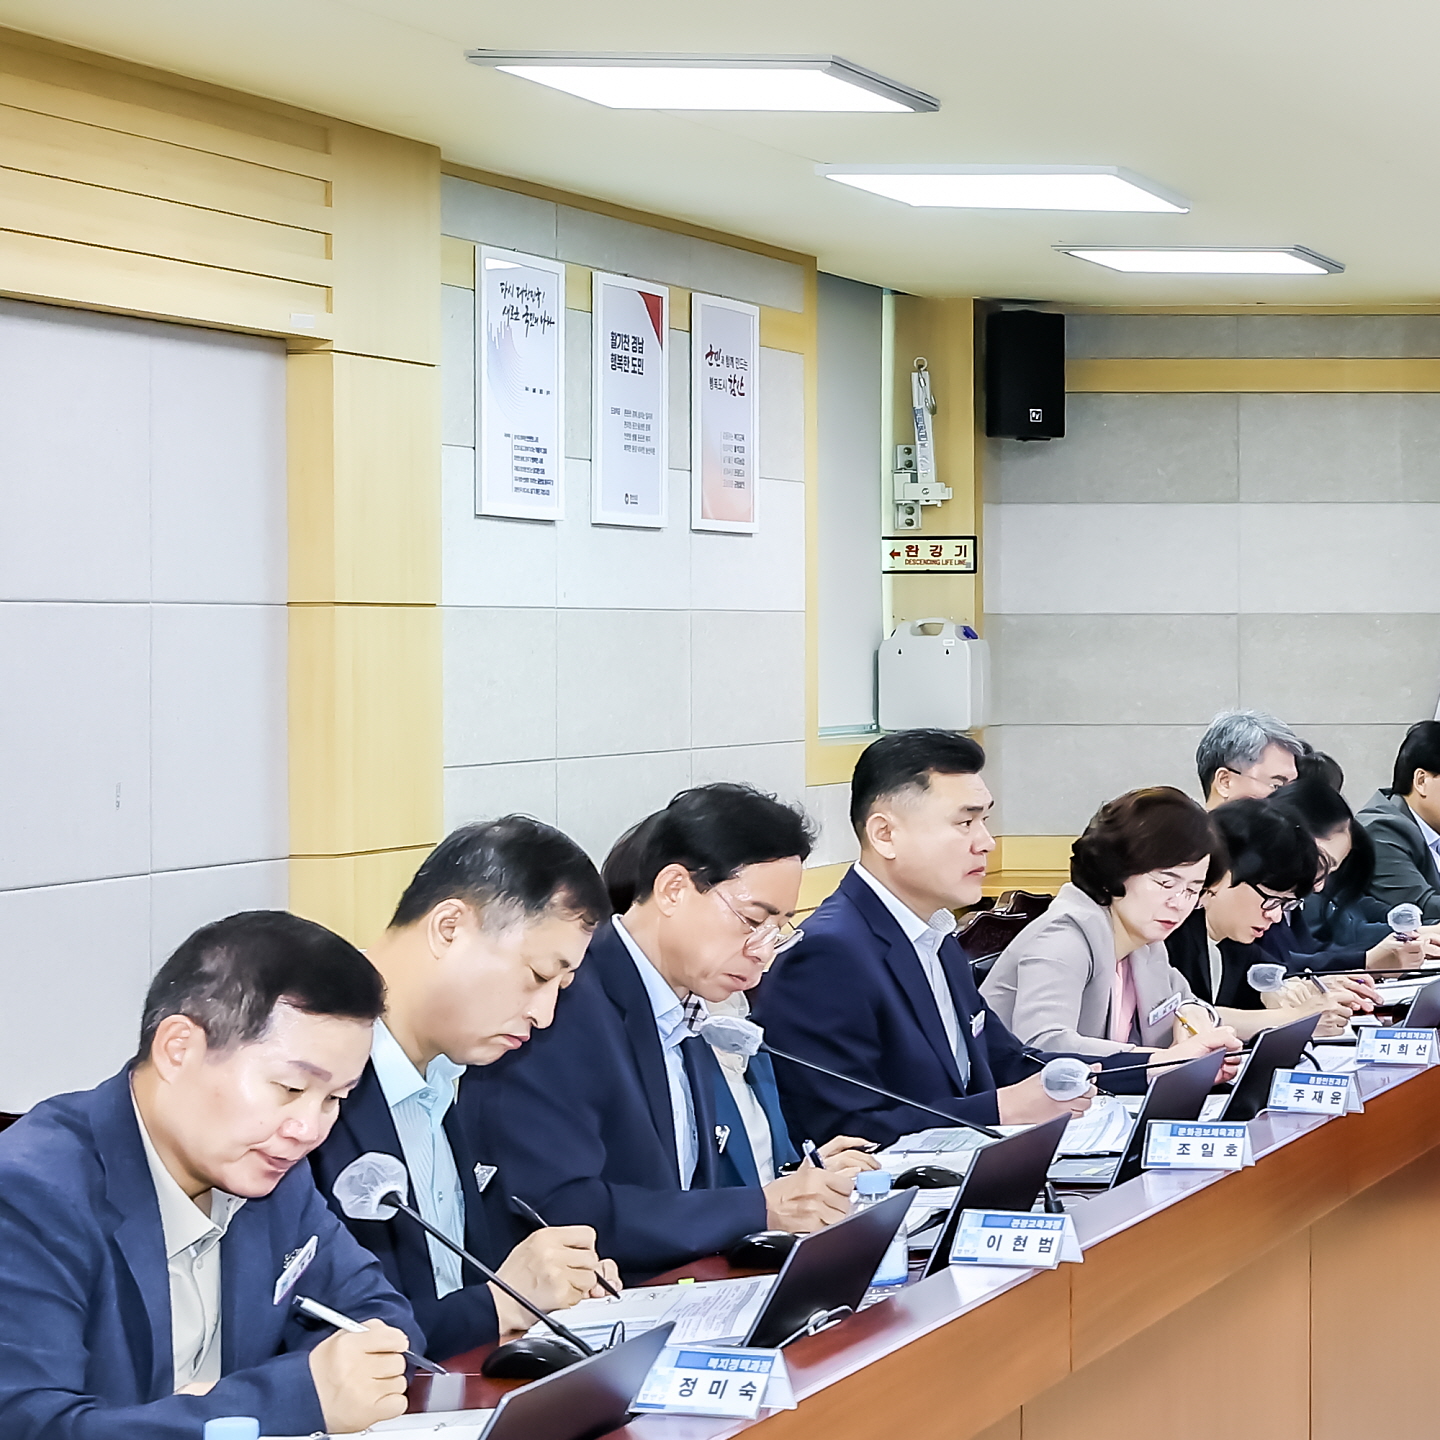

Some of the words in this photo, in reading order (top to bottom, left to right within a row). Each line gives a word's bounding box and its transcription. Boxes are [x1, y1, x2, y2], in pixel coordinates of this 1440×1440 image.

[500, 281, 514, 299] 다시
[611, 331, 630, 351] 활기찬
[631, 335, 645, 354] 경남
[611, 353, 630, 373] 행복한
[631, 357, 644, 375] 도민
[1379, 1043, 1427, 1056] 지희선
[1293, 1088, 1342, 1105] 주재윤
[1176, 1143, 1238, 1158] 조일호
[986, 1234, 1054, 1254] 이현범
[678, 1376, 757, 1402] 정미숙
